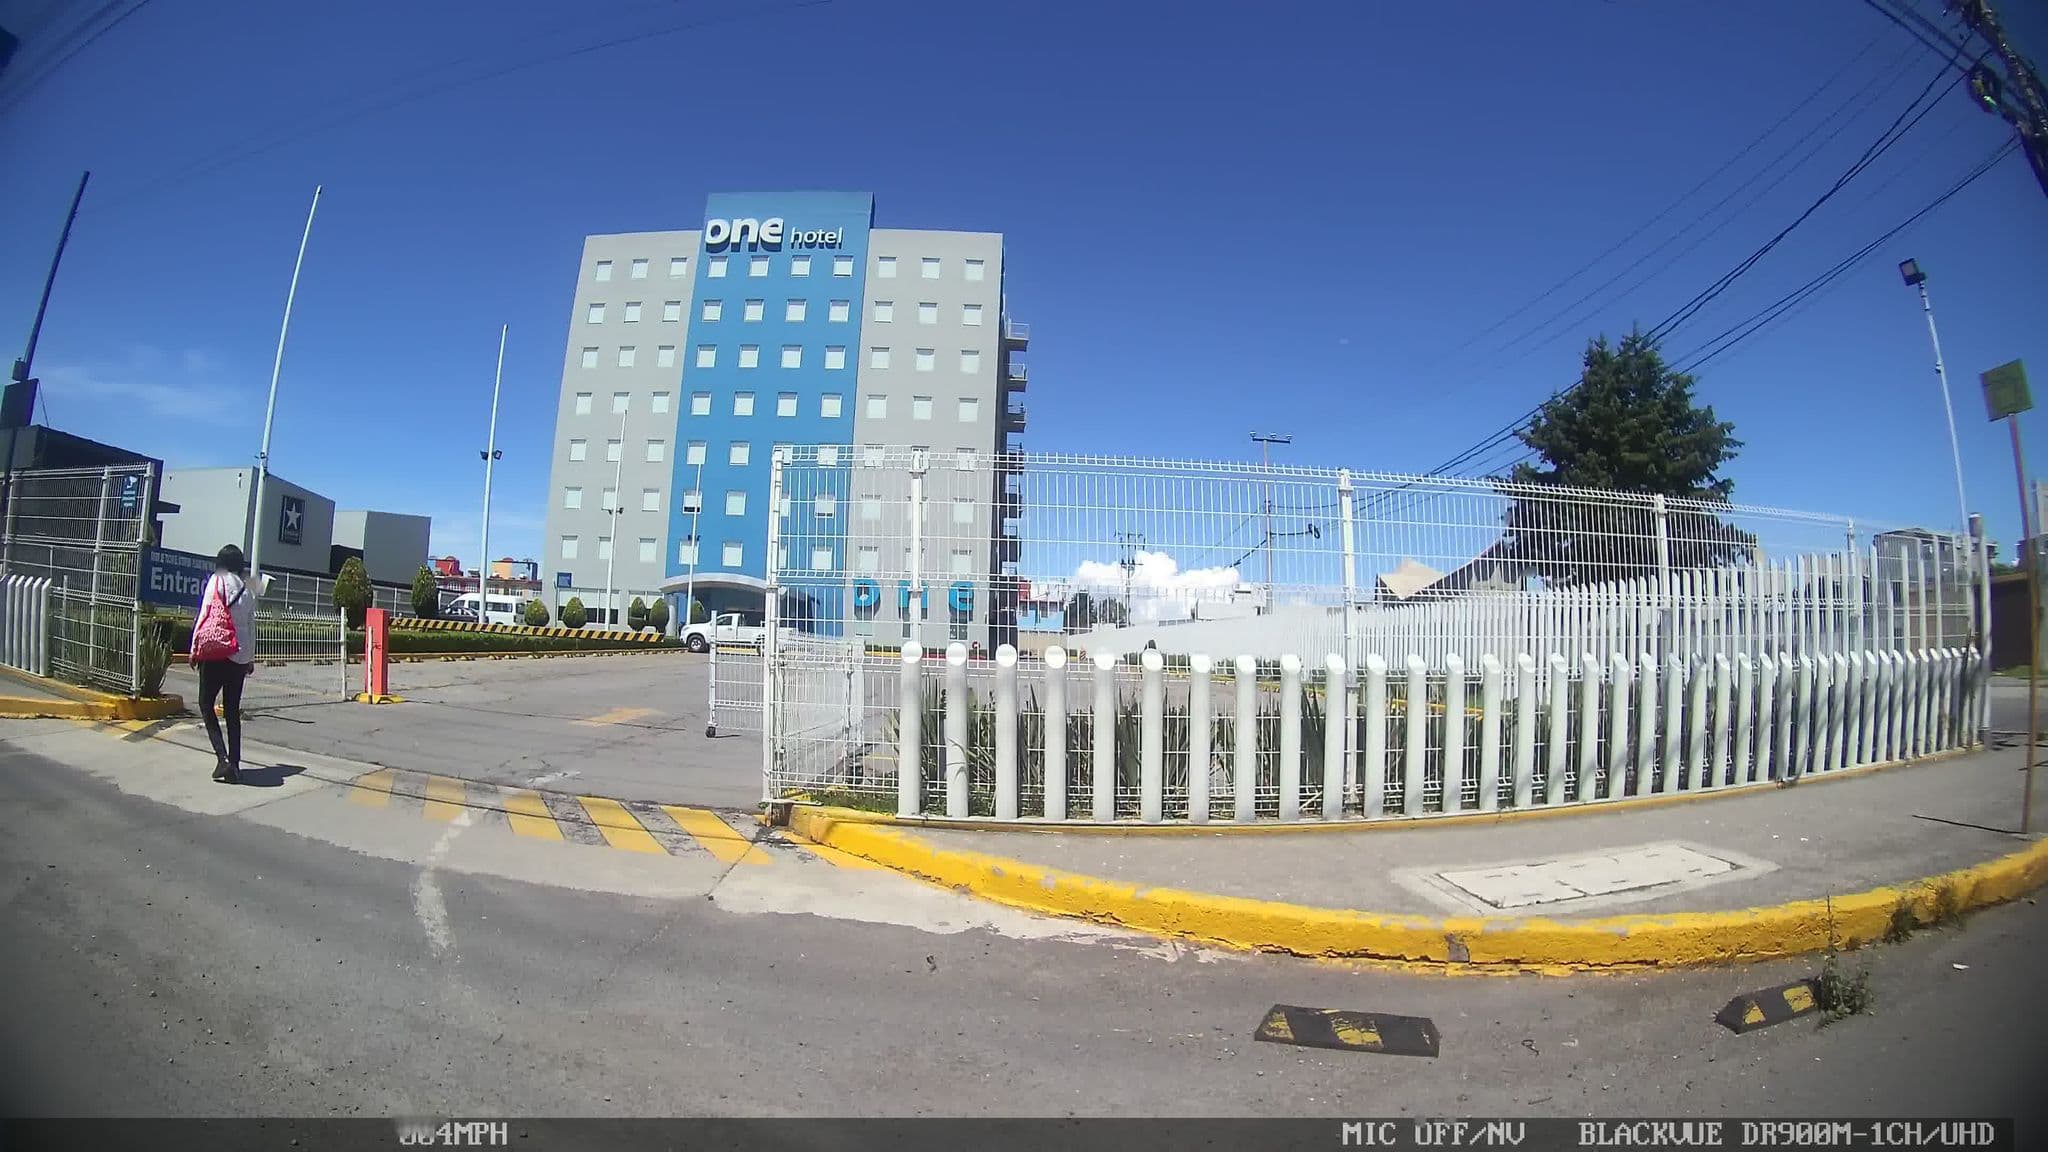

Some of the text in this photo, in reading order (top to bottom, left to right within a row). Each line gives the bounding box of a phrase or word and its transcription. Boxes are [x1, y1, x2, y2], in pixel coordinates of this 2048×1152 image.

[705, 217, 843, 247] one hotel
[853, 578, 974, 612] one
